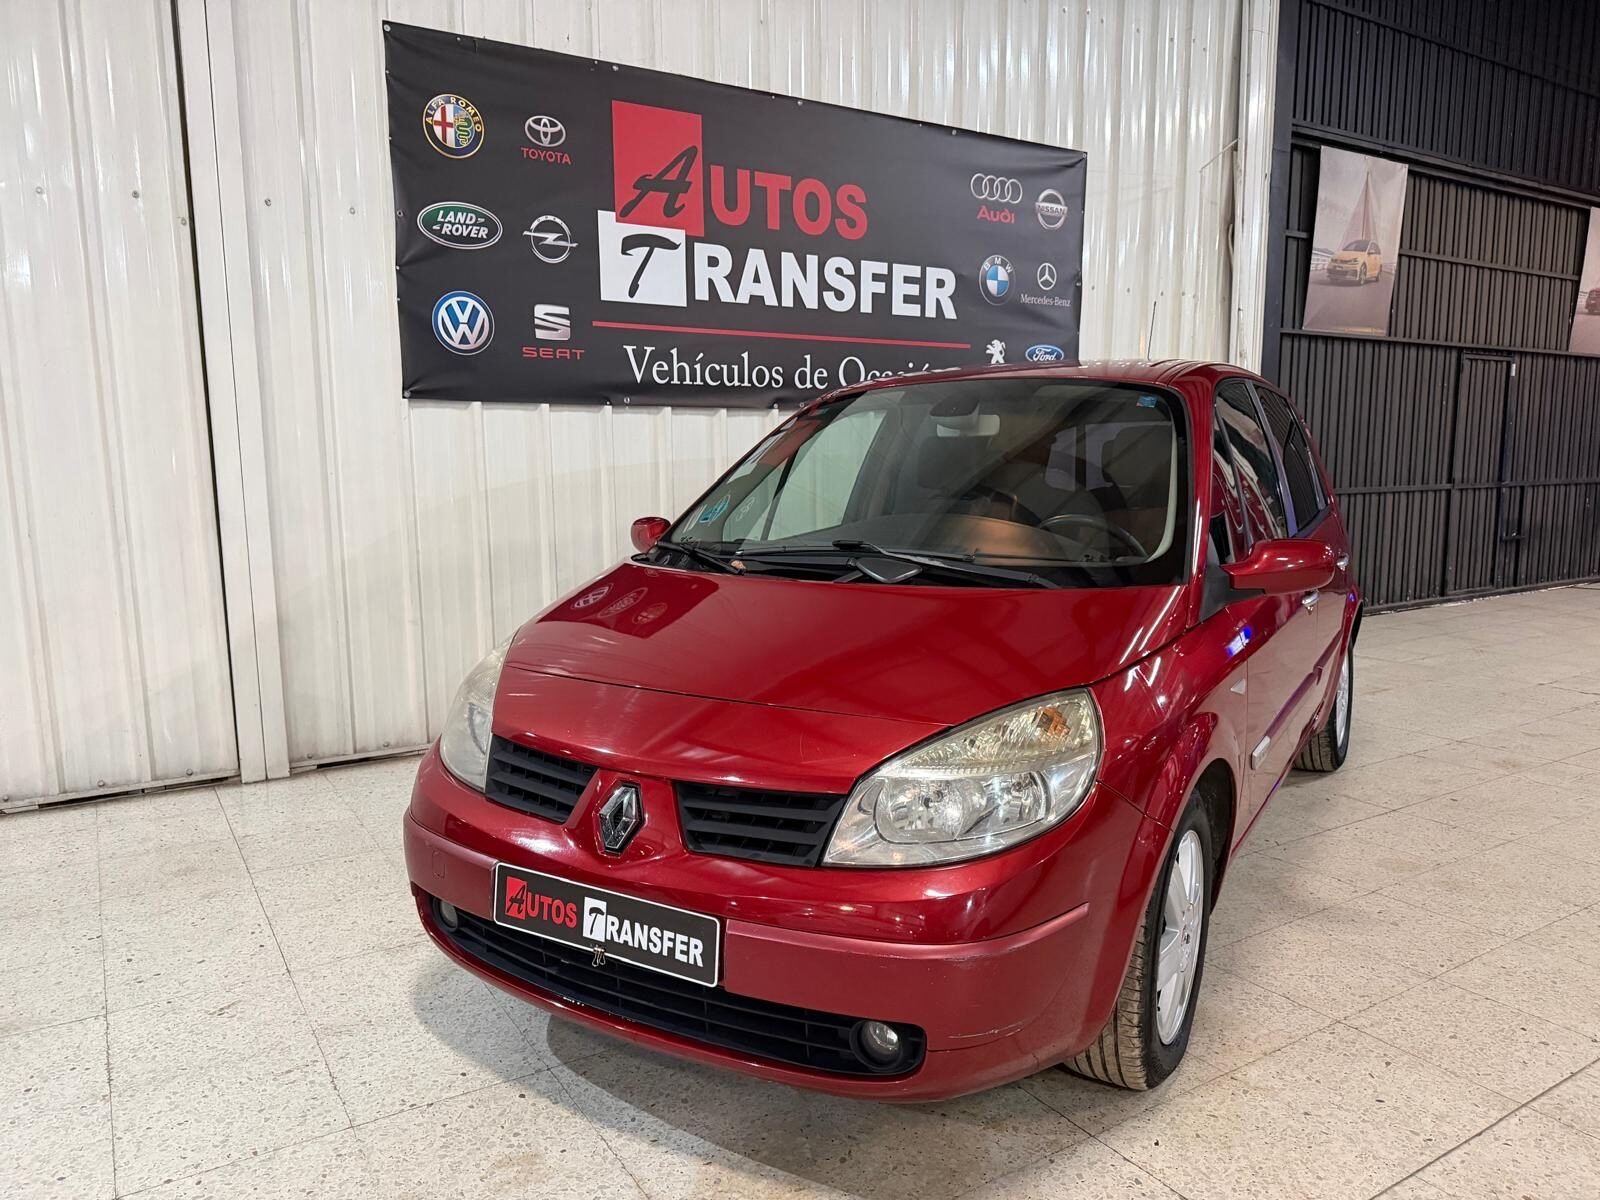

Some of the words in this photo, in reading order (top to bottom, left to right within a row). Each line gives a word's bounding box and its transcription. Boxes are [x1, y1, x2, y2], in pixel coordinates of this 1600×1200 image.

[425, 97, 445, 125] ALFA
[450, 97, 482, 132] ROMEO
[521, 147, 571, 165] TOYOTA
[620, 145, 869, 240] AUTOS
[437, 210, 477, 224] LAND
[977, 205, 1015, 223] Audi
[1038, 204, 1067, 215] NISSAN
[441, 224, 488, 239] ROVER
[620, 233, 957, 319] TRANSFER
[1020, 294, 1072, 307] Mercedes-Benz
[522, 346, 584, 360] SEAT
[623, 345, 784, 388] Vehículos
[794, 354, 828, 389] de
[506, 886, 577, 928] AUTOS
[588, 907, 704, 967] TRANSFER
